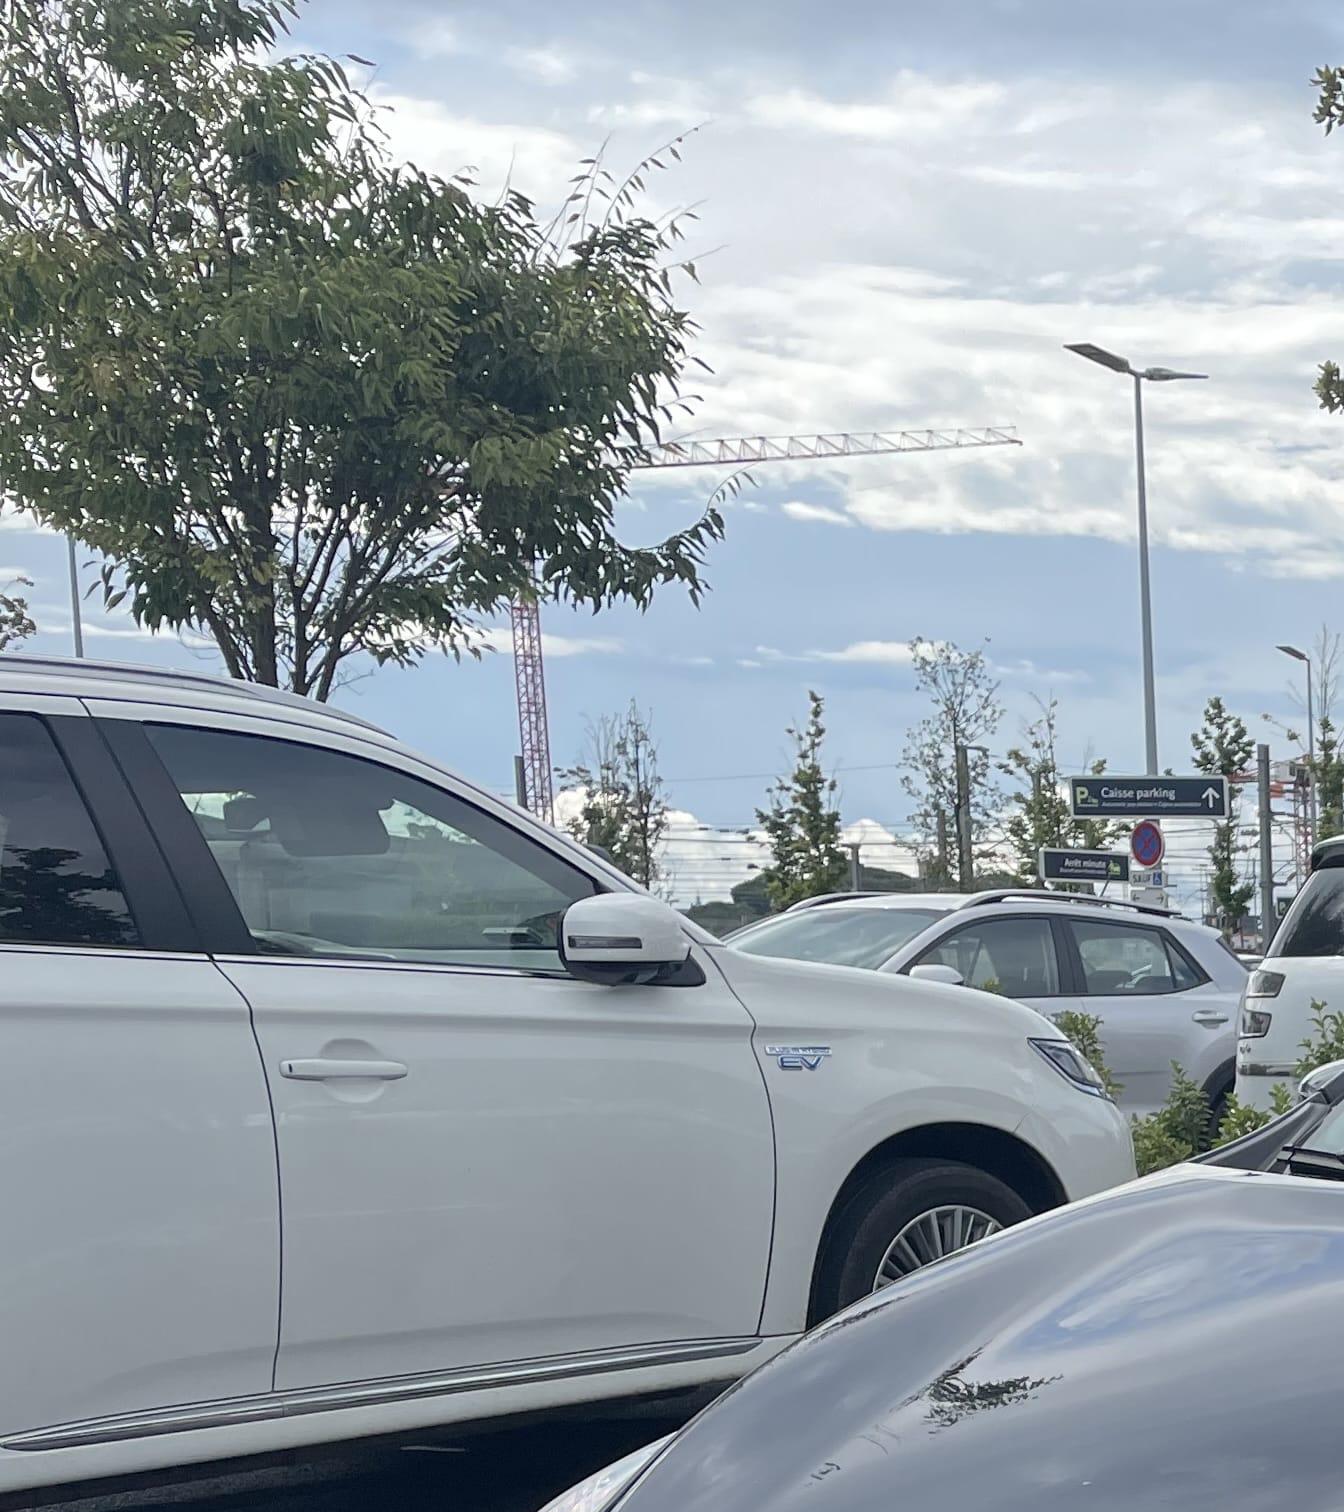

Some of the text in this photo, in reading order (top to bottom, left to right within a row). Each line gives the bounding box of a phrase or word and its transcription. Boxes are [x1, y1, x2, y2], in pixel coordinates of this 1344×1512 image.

[1100, 787, 1176, 801] Caisse parking
[778, 1055, 824, 1071] EV
